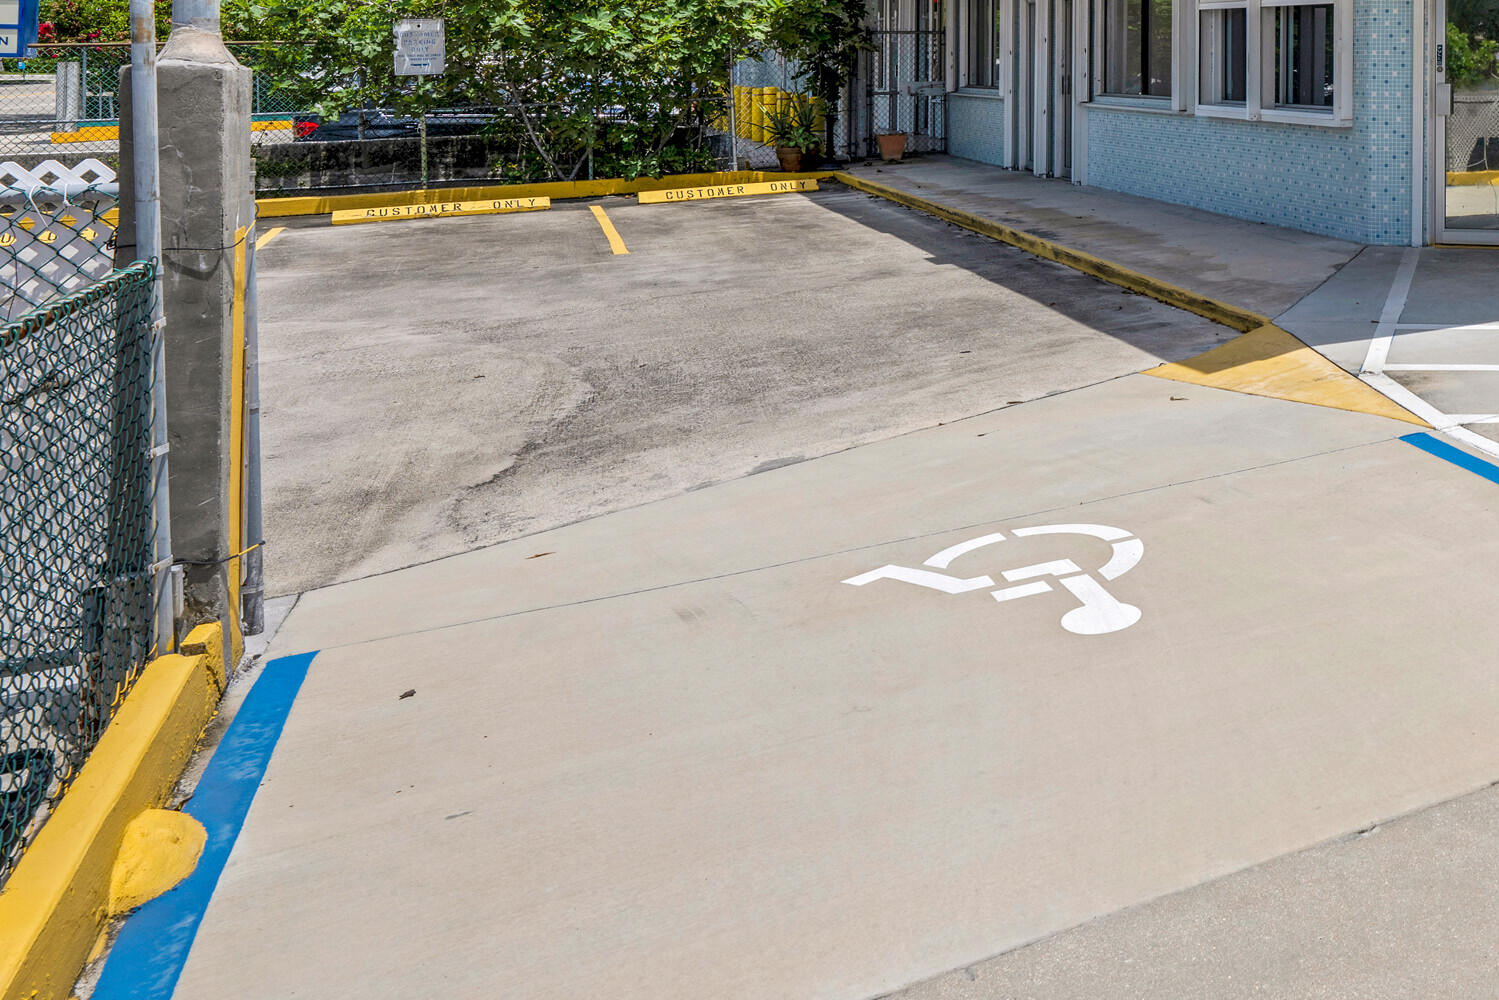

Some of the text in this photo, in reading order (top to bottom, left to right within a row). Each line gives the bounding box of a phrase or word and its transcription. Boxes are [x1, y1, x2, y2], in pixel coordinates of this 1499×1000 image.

[666, 181, 807, 200] CUSTOMER ONLY
[366, 198, 537, 218] CUSTOMER ONLY
